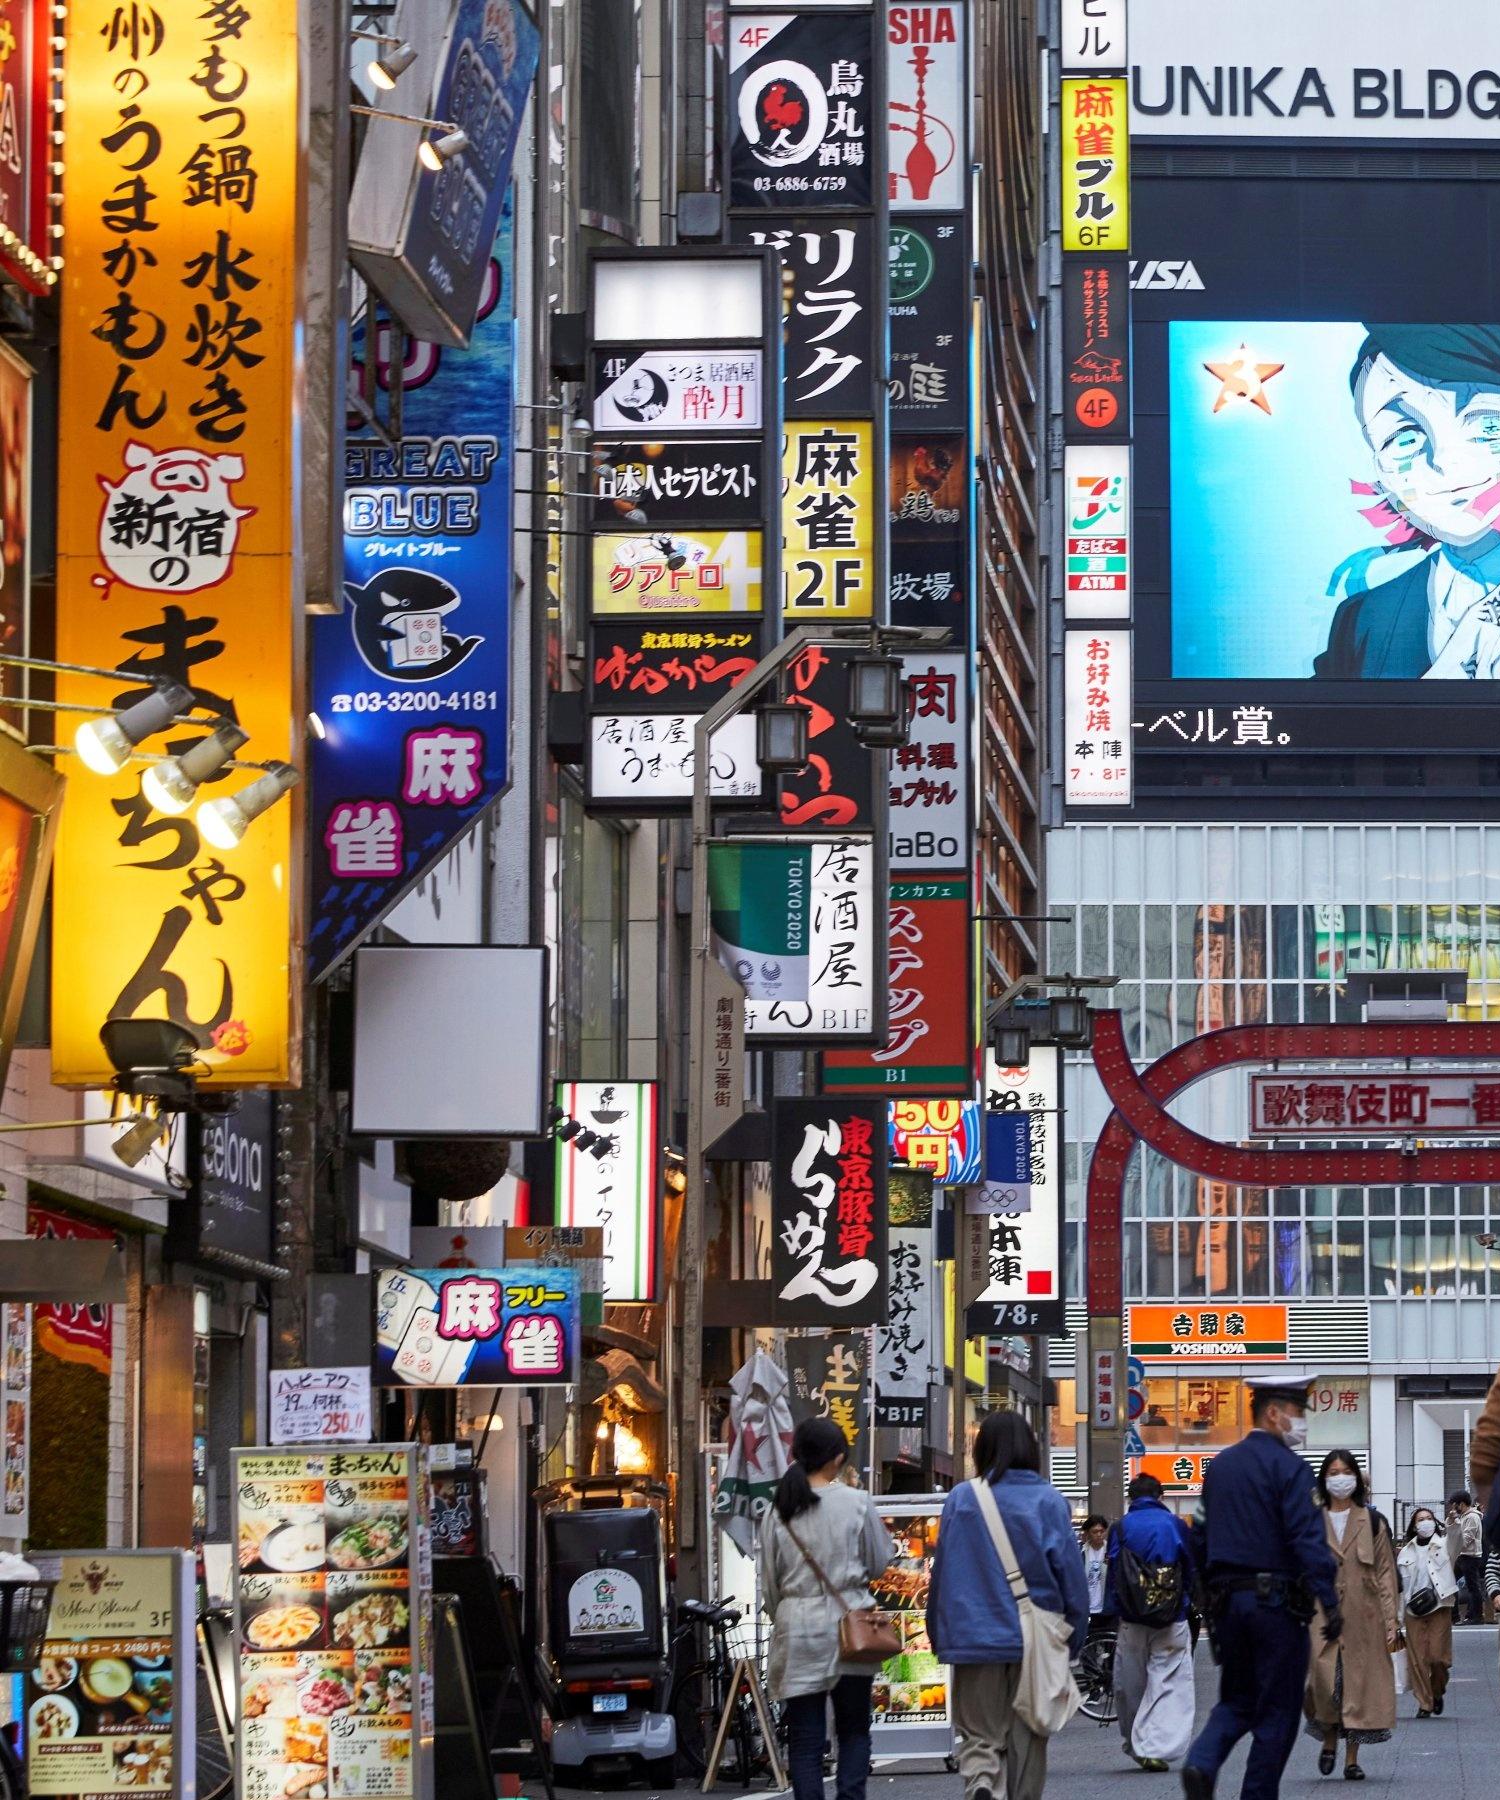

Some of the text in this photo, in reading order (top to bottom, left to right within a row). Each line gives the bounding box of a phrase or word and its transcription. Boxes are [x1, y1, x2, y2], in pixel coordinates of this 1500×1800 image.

[739, 28, 768, 48] 4F
[1132, 65, 1336, 118] UNIKA
[753, 176, 848, 191] 03-6886-6759
[937, 227, 954, 238] 3F
[1079, 226, 1110, 246] 6F
[181, 230, 265, 443] 水炊き
[936, 335, 953, 347] 3F
[603, 358, 627, 378] 4F
[1084, 399, 1109, 417] 4F
[344, 437, 499, 484] GREAT
[796, 428, 861, 552] 麻雀
[347, 488, 481, 536] BLUE
[107, 493, 231, 559] 新宿
[364, 542, 461, 558] グレイトブルー
[1075, 540, 1119, 554] たばこ
[608, 563, 724, 593] クアトロ
[796, 560, 861, 607] 2F
[1078, 575, 1116, 590] ATM
[1086, 638, 1111, 732] お好み焼
[353, 691, 498, 712] 03-3200-4181
[787, 858, 802, 951] TOKYO 2020
[822, 1008, 869, 1030] B1F
[714, 997, 734, 1108] 劇場通り一番街
[885, 1069, 907, 1083] B1
[837, 1115, 875, 1258] 東京豚骨
[507, 1286, 566, 1307] フリー
[888, 1407, 924, 1422] B1F
[150, 1611, 171, 1629] 3F
